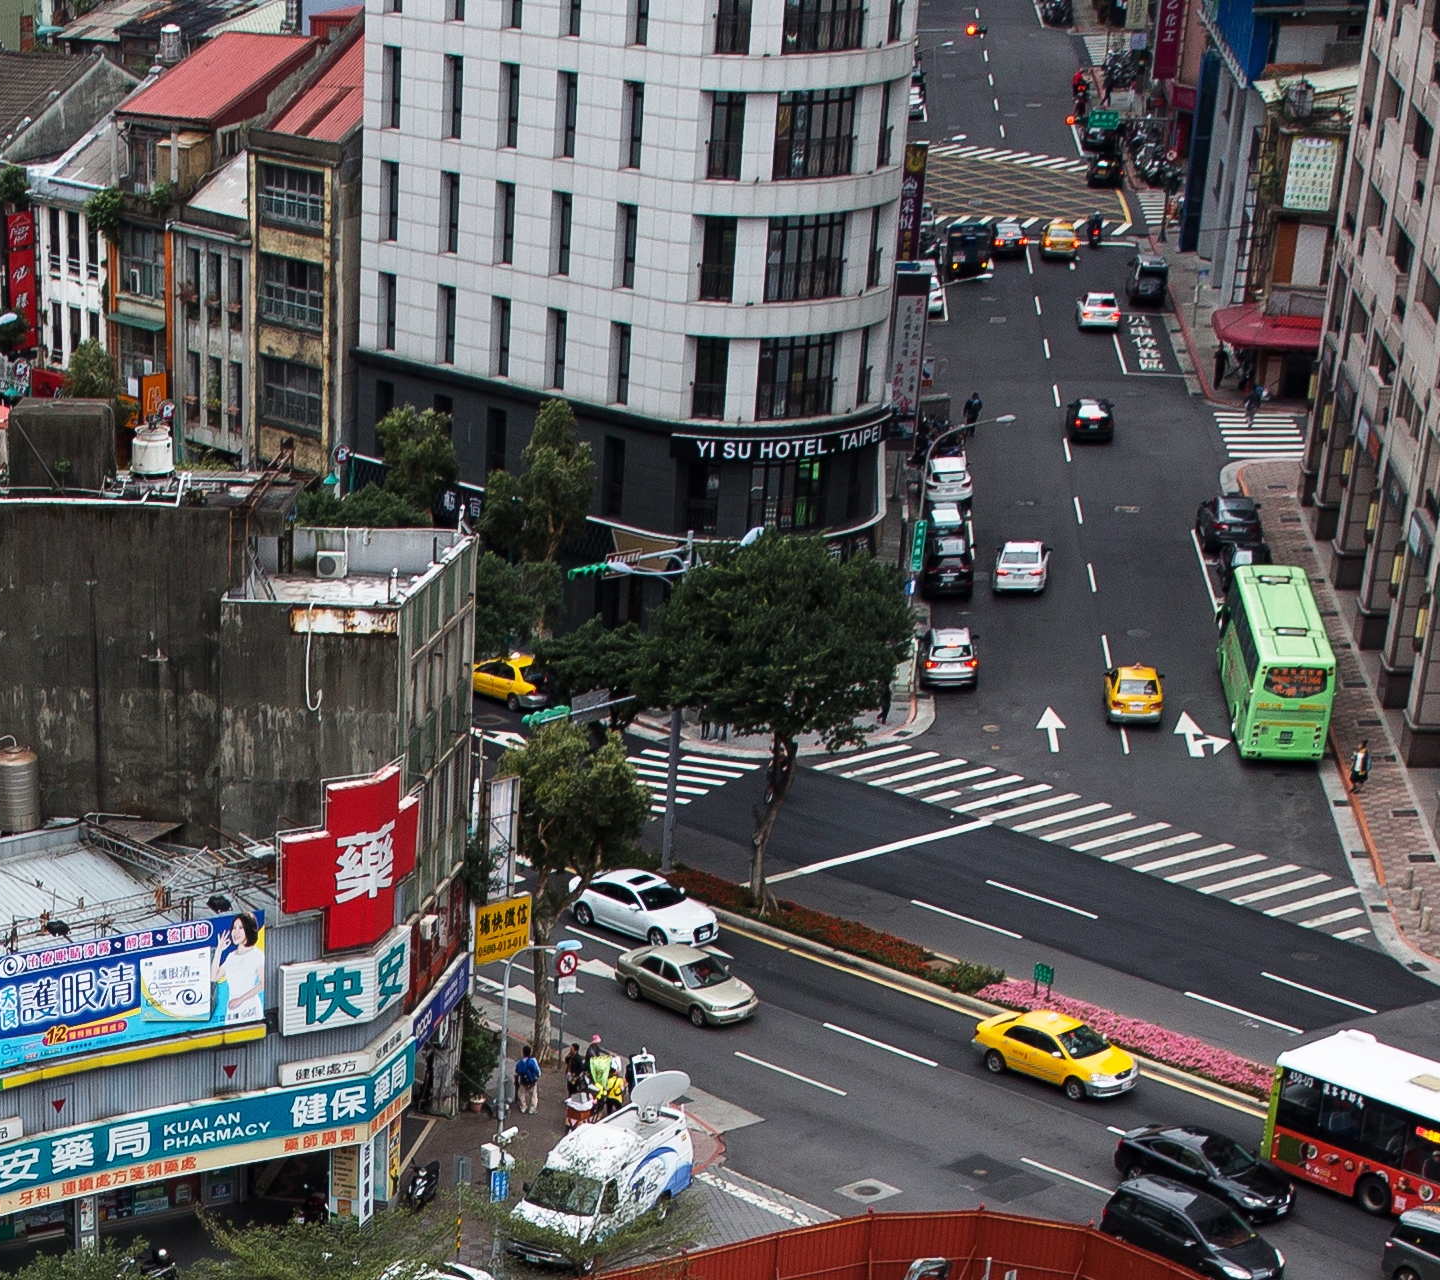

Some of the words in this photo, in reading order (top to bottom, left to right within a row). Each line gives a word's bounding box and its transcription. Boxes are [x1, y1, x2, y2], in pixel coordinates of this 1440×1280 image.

[696, 440, 716, 458] YI
[722, 441, 752, 459] SU
[840, 424, 883, 451] TAIPEI
[333, 819, 397, 904] 藥
[19, 962, 136, 1023] 護眼清
[297, 942, 406, 1025] 快安
[294, 1059, 358, 1082] 健保處方
[163, 1117, 209, 1136] KUAI
[213, 1111, 242, 1125] AN
[163, 1120, 271, 1151] PHARMACY
